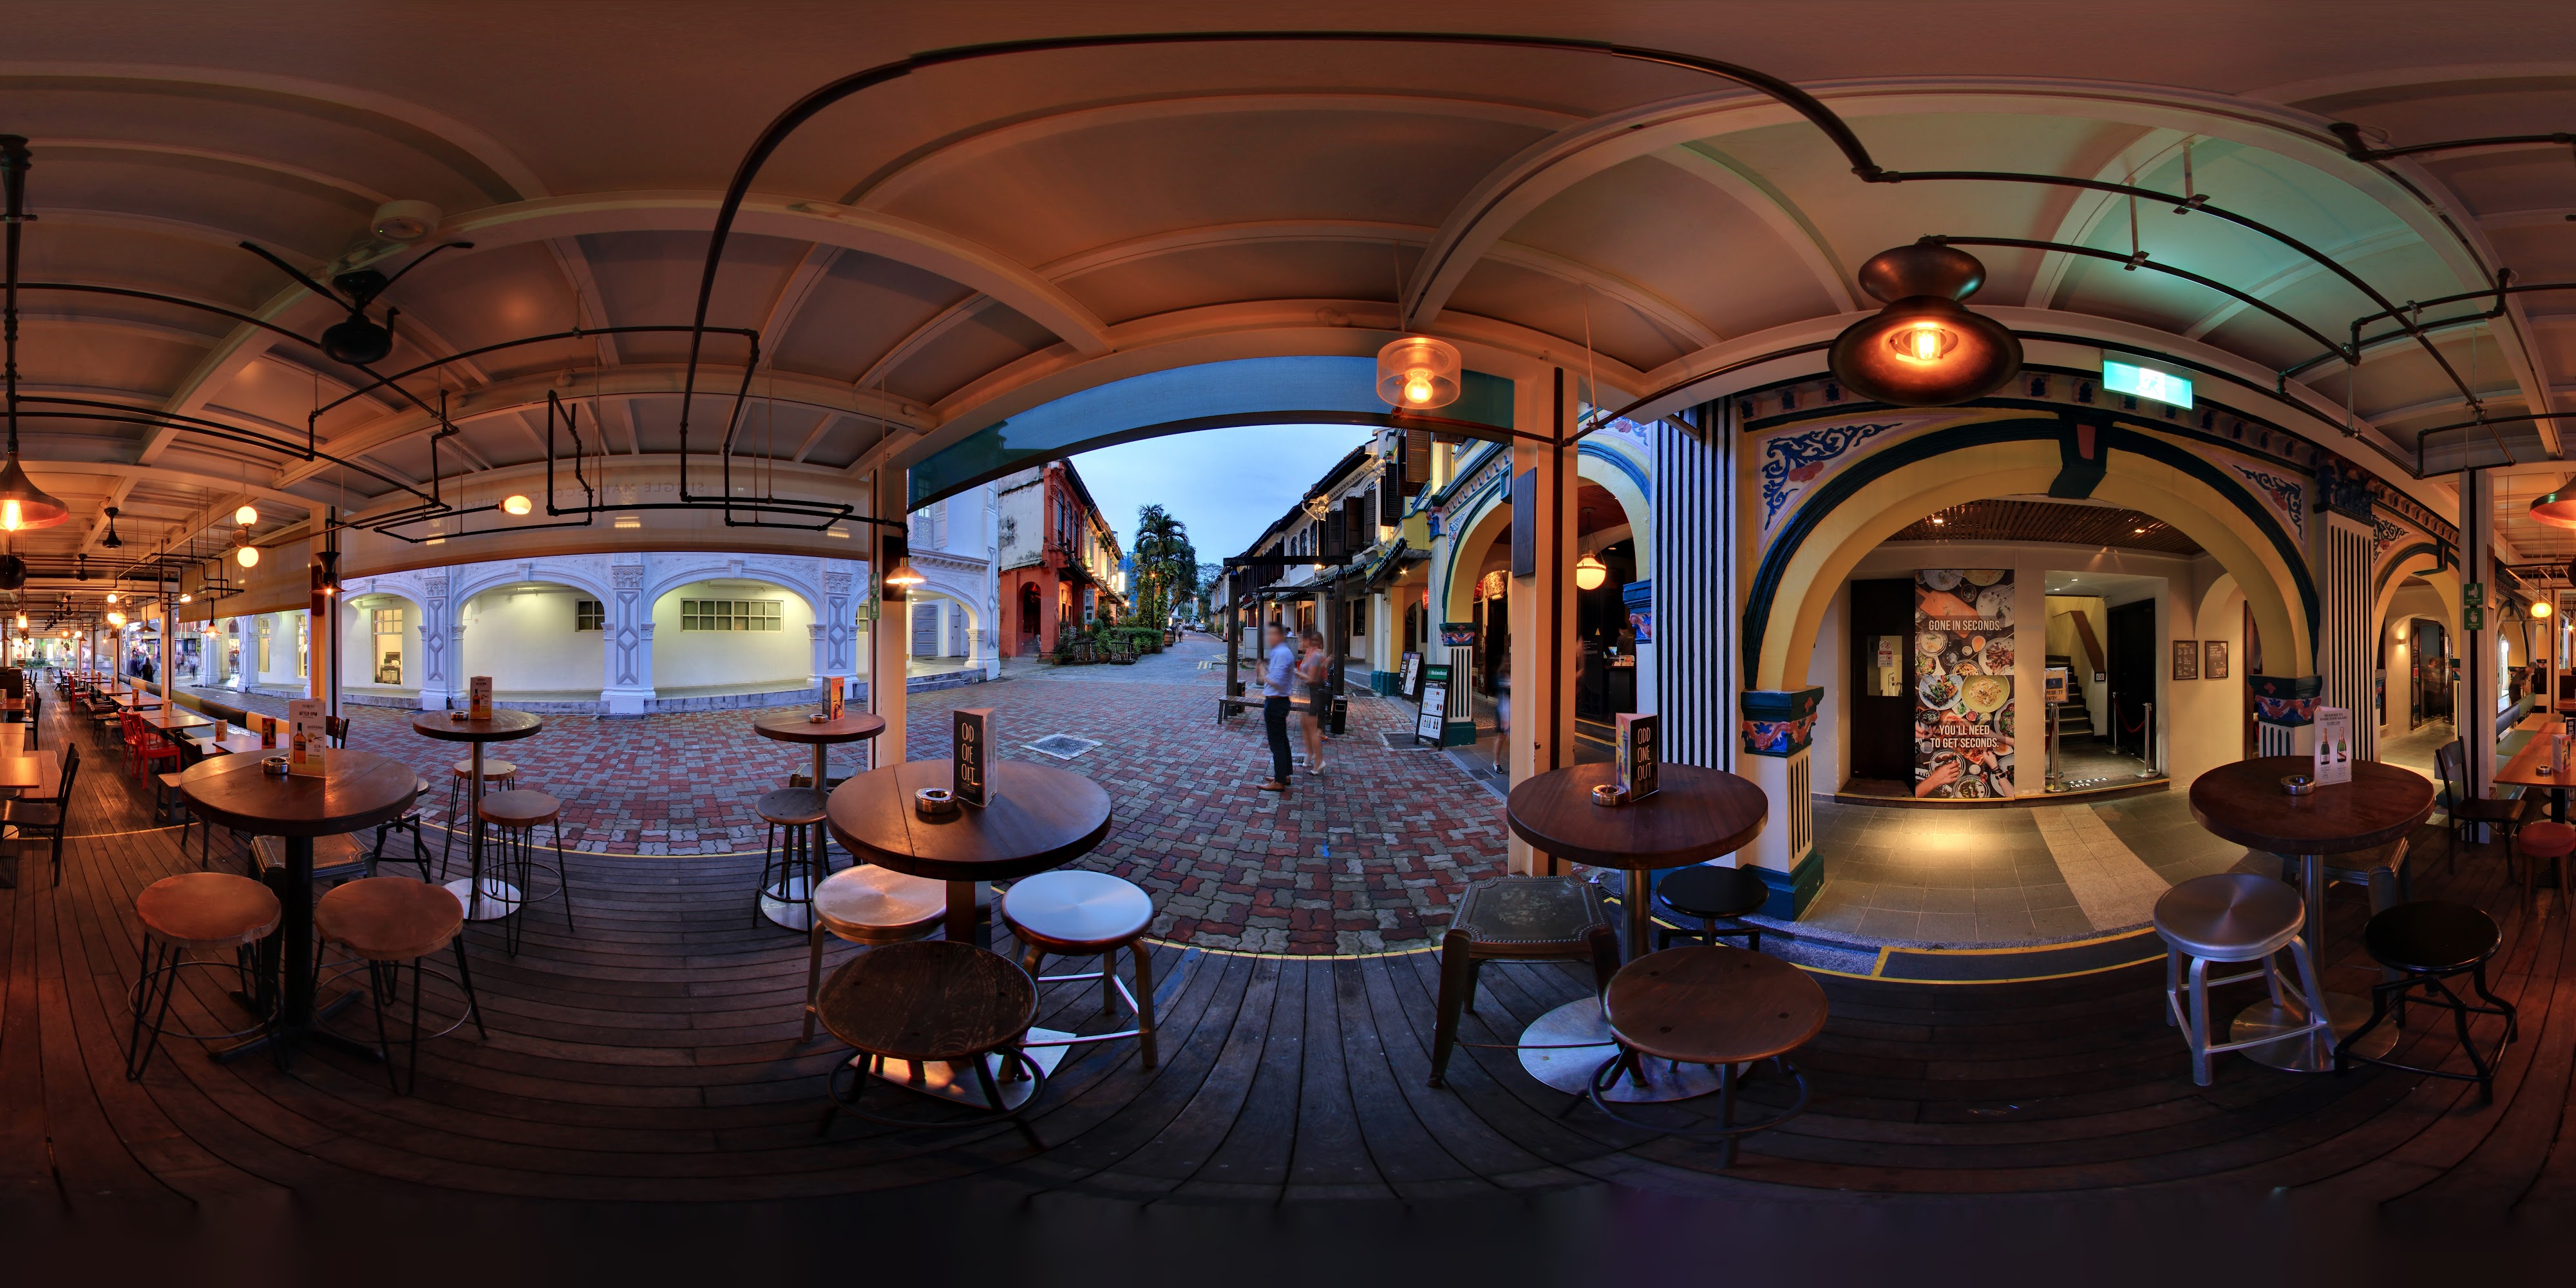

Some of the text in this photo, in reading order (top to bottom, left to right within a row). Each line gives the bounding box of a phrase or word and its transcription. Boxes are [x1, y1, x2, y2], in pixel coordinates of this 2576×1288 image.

[1929, 620, 2002, 630] GONE IN SECONDS.
[1638, 727, 1651, 744] ODD
[1939, 725, 1990, 735] YOU'LL NEED
[1930, 738, 1999, 748] TO GET SECONDS.
[1638, 745, 1650, 762] ONE
[1638, 762, 1651, 781] OUT
